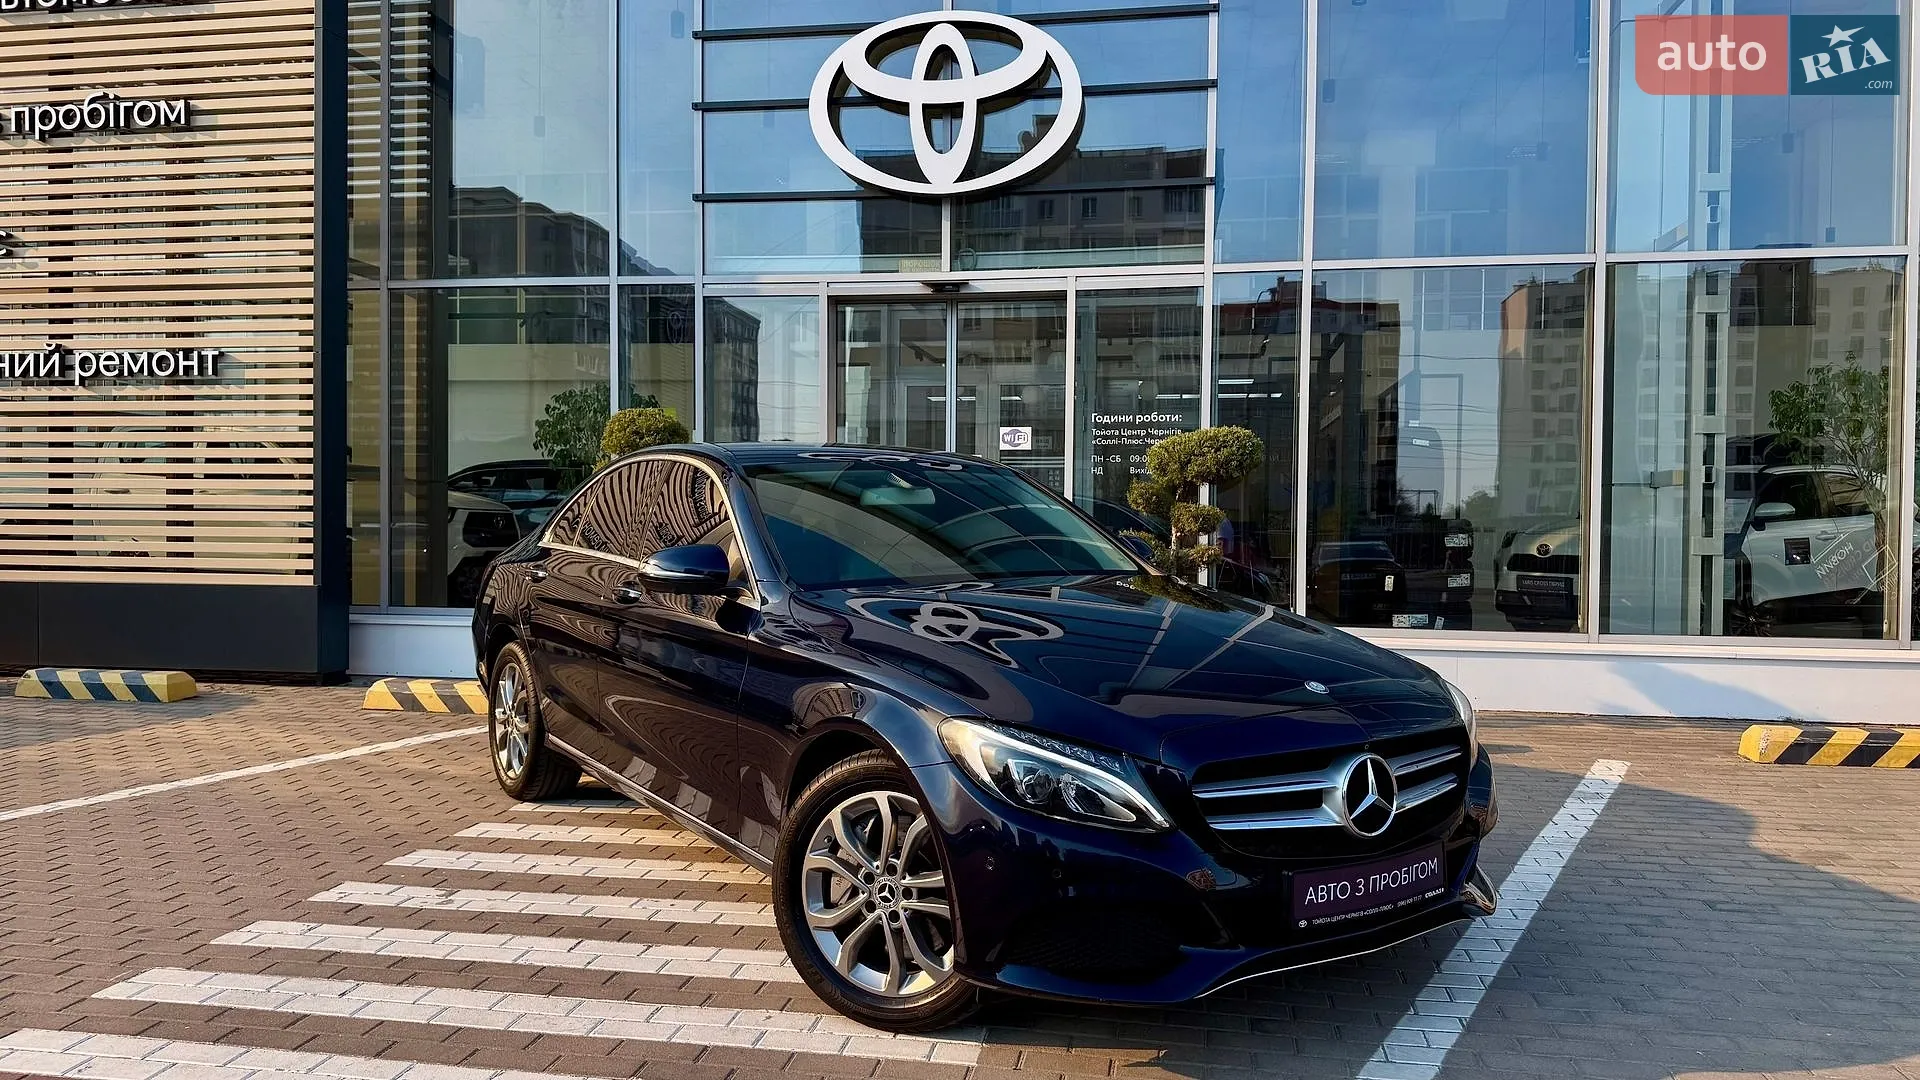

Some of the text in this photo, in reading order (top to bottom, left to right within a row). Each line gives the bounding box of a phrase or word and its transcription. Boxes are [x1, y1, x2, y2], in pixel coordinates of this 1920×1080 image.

[11, 90, 187, 141] пробігом
[75, 349, 219, 386] ремонт
[1091, 411, 1183, 424] Години роботи:
[1091, 428, 1119, 436] Тойота
[1121, 428, 1147, 436] Центр
[1091, 467, 1103, 475] НД
[1304, 881, 1351, 905] АВТО
[1369, 857, 1438, 893] ПРОБІГОМ
